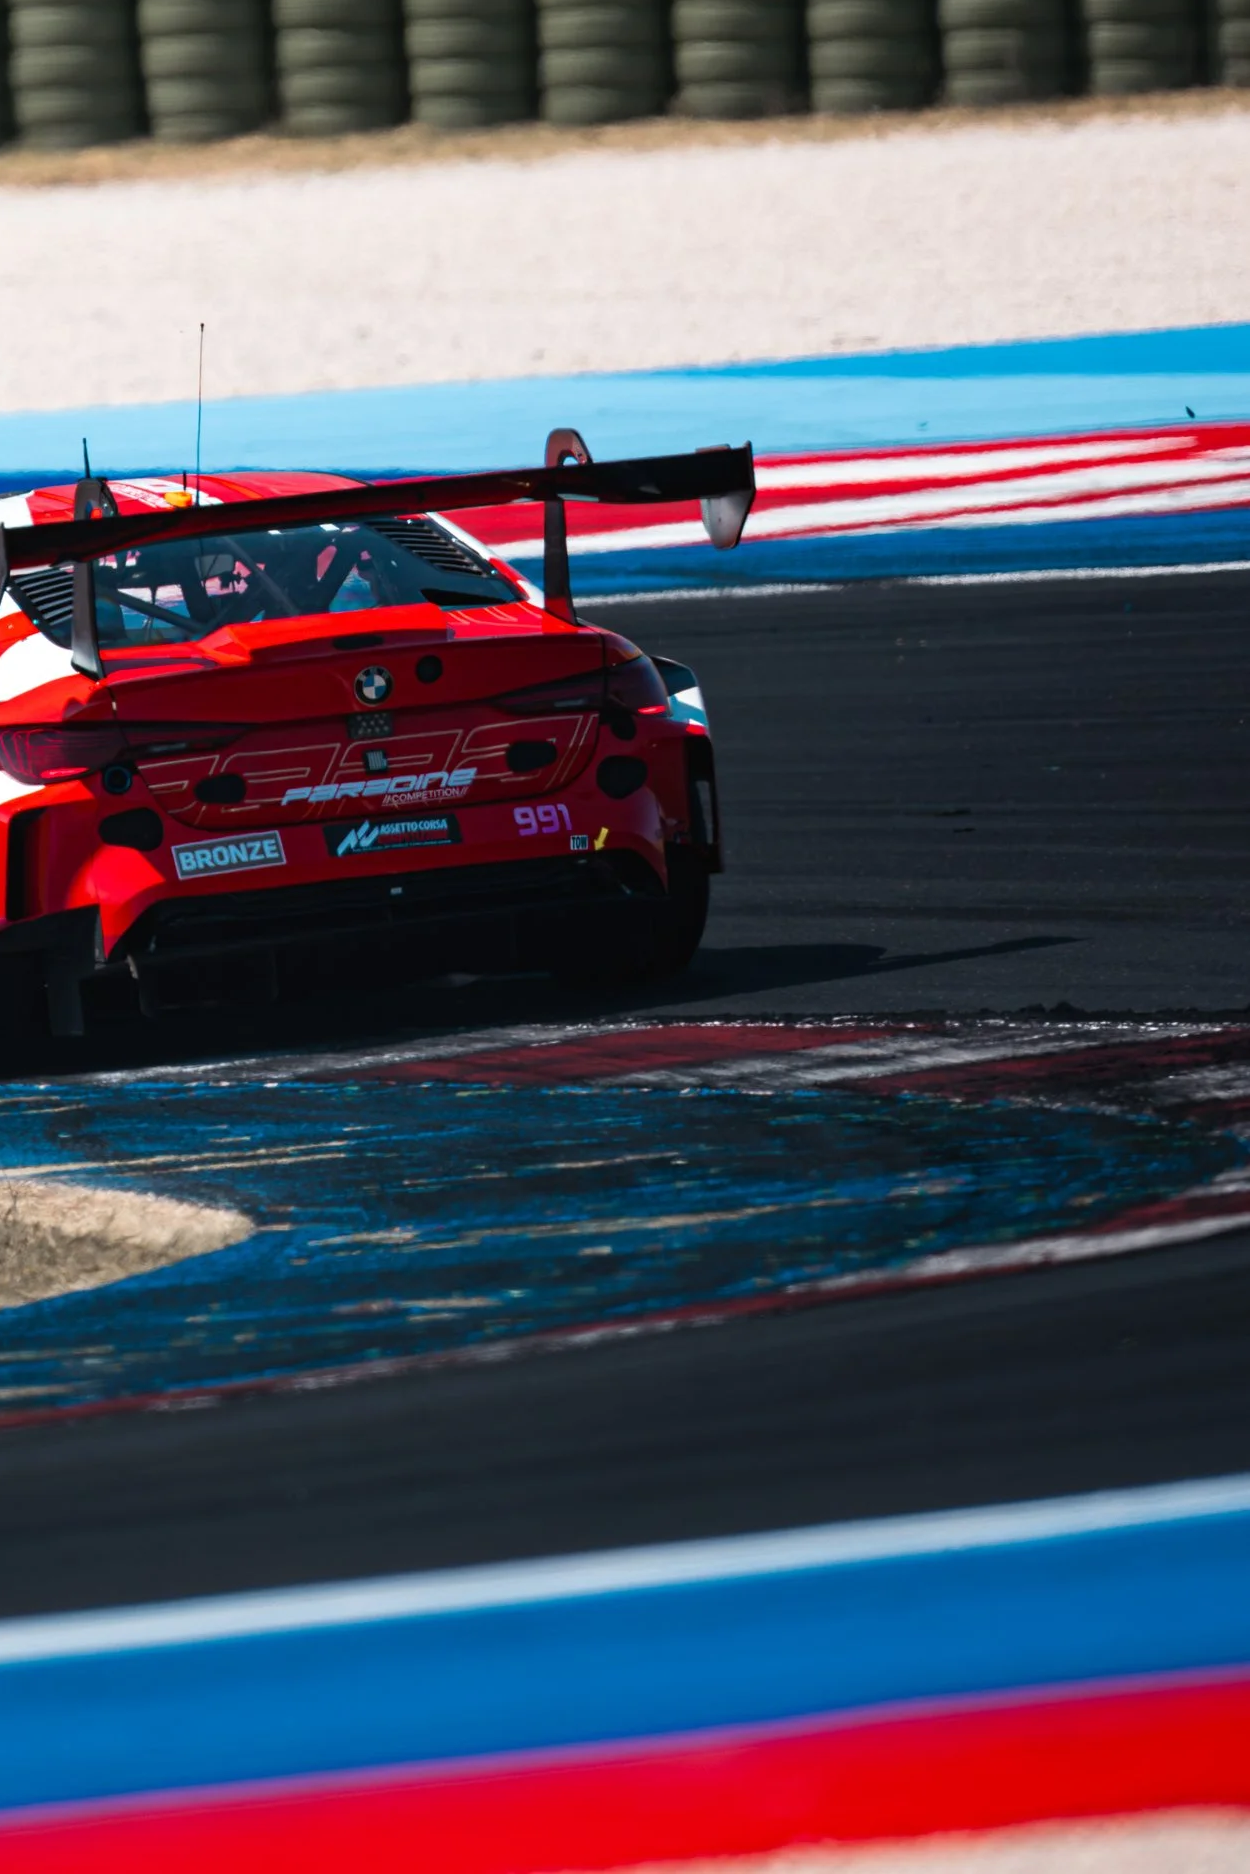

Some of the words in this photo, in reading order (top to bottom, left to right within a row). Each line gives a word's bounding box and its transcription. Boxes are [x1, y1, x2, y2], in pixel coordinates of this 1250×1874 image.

[379, 821, 418, 835] ASSETTO
[418, 818, 448, 832] CORSA
[513, 803, 572, 836] 991
[178, 838, 280, 871] BRONZE
